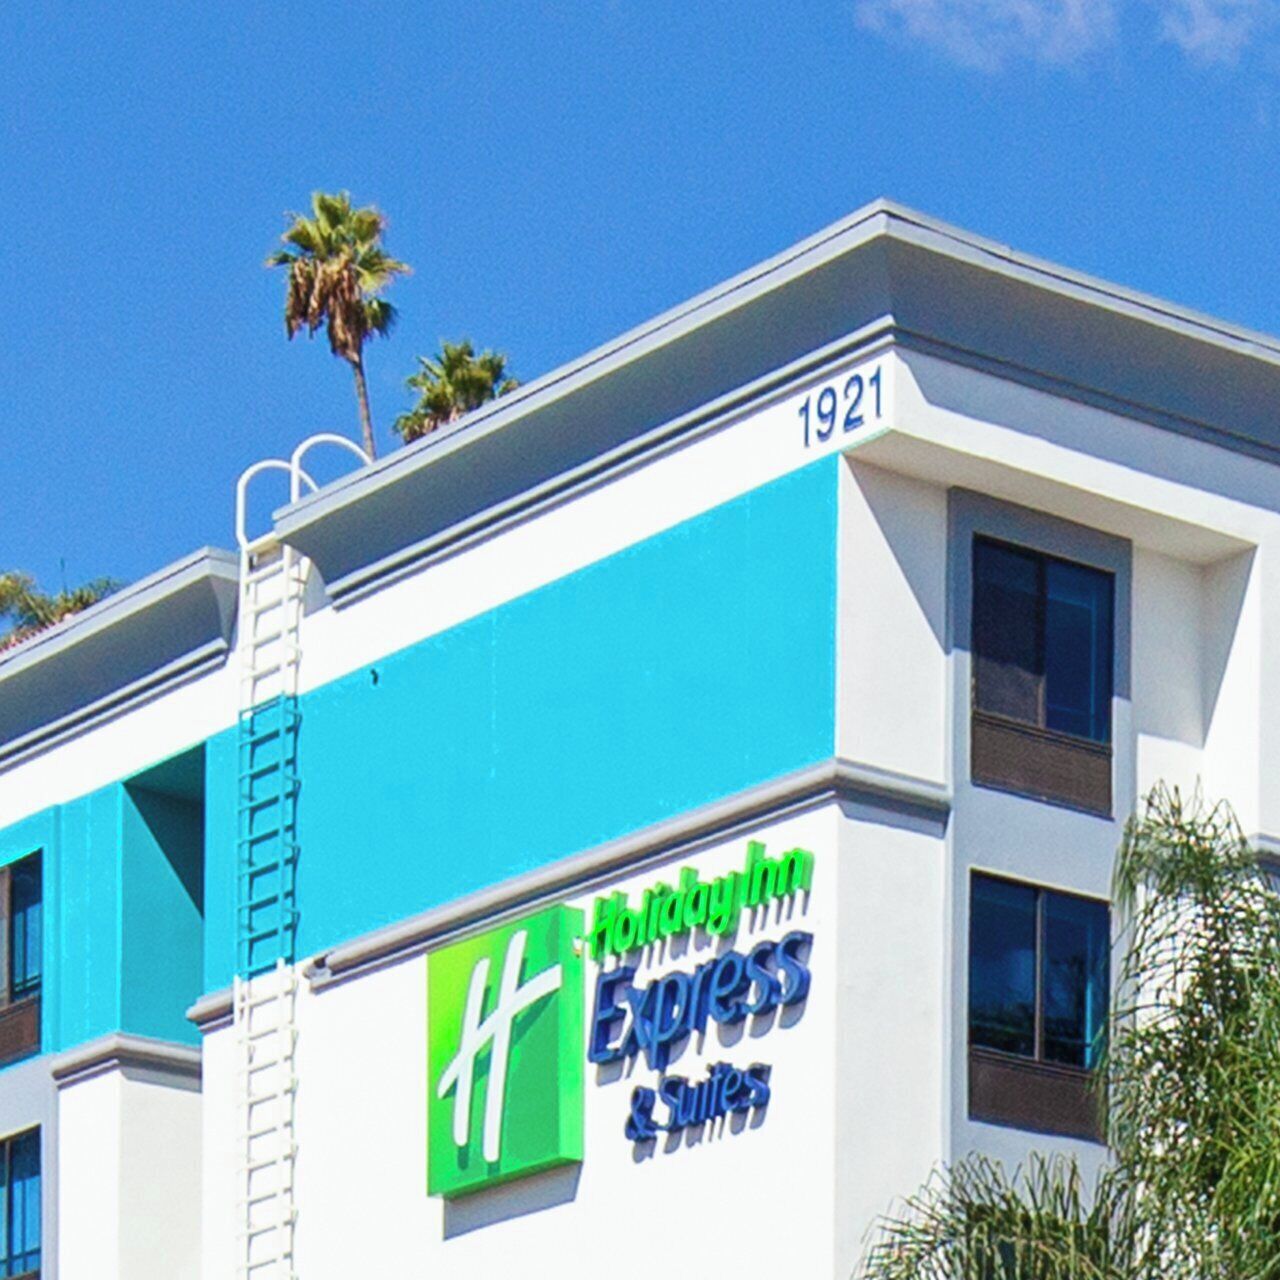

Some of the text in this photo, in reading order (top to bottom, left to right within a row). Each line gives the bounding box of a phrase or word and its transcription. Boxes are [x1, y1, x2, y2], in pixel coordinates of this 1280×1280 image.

[798, 364, 883, 448] 1921
[588, 840, 815, 963] Holiday Inn
[587, 931, 814, 1073] Express
[624, 1060, 772, 1141] & Suites
